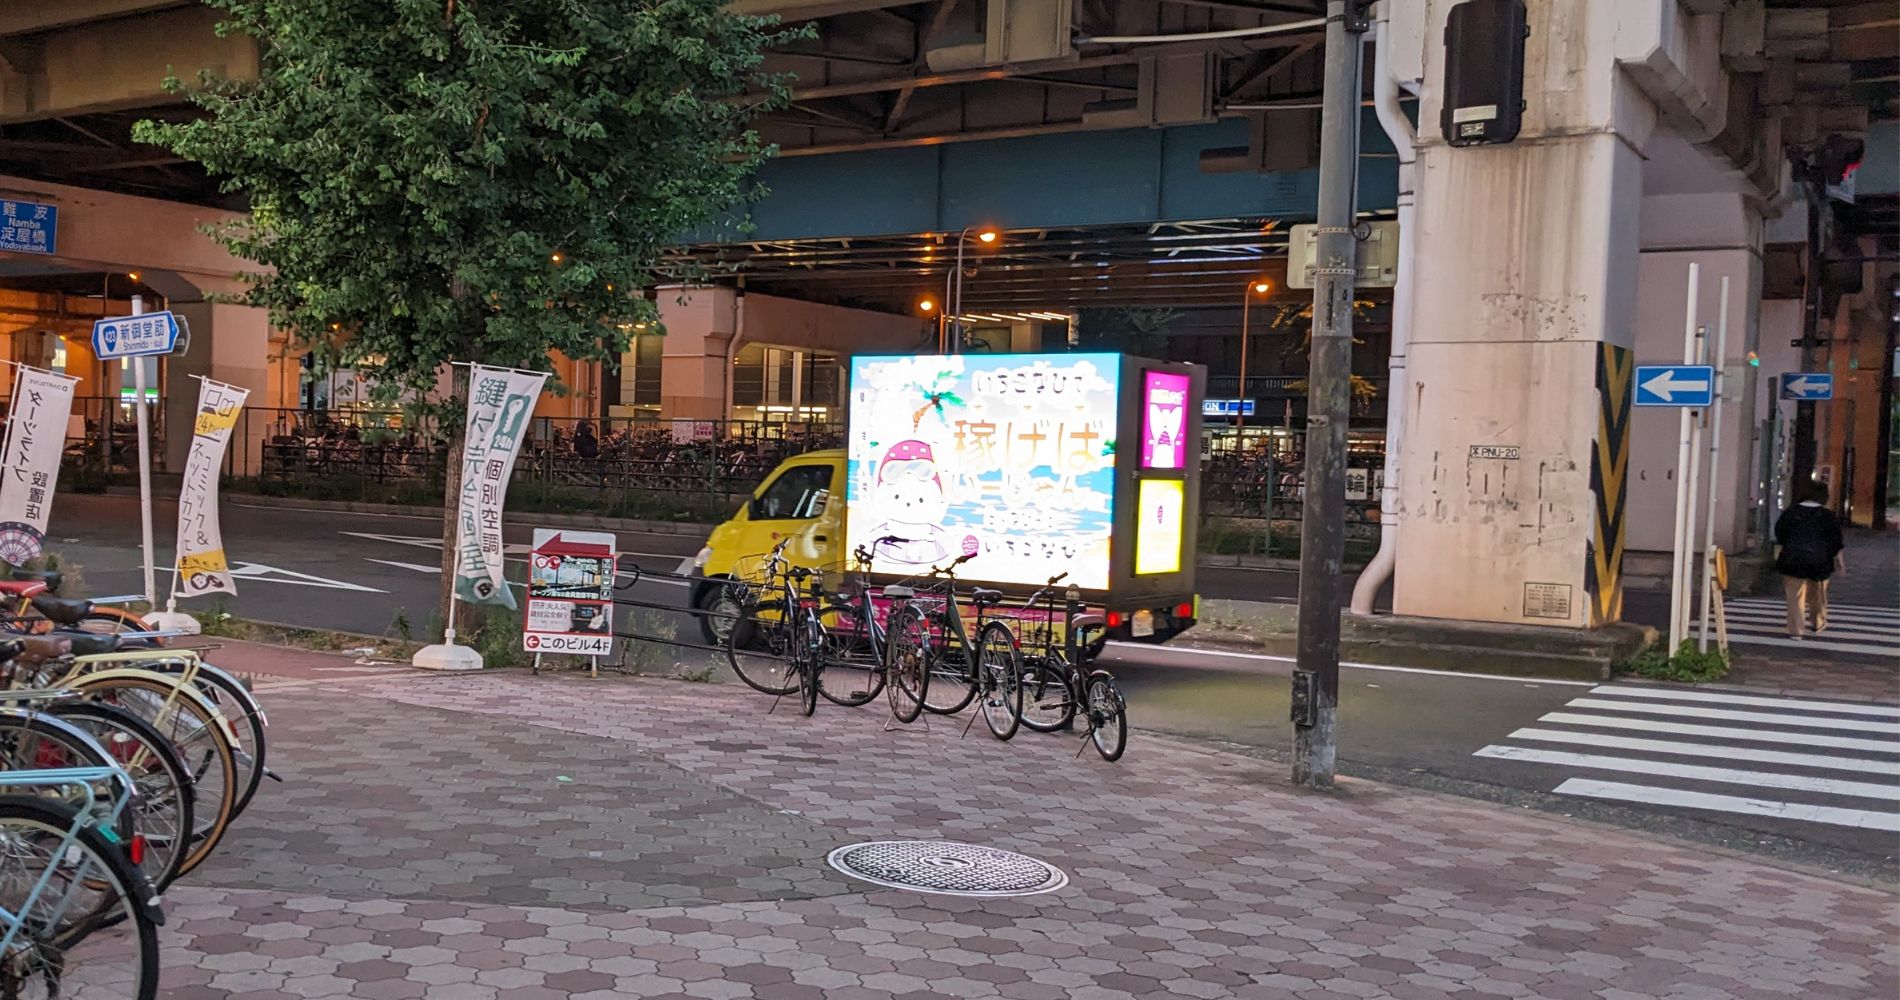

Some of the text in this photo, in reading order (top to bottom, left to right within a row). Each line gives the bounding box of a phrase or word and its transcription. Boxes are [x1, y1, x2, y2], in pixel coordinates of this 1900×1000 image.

[3, 202, 48, 220] 難波
[9, 217, 41, 229] Namba
[1, 226, 46, 244] 淀屋橋
[0, 241, 47, 252] Yodoyabashi
[120, 319, 165, 341] 新御堂筋
[493, 434, 513, 450] 24h
[953, 419, 1105, 471] 稼げば
[1346, 473, 1365, 493] 輪
[480, 458, 504, 555] 個別空調
[541, 636, 610, 652] このビル4F
